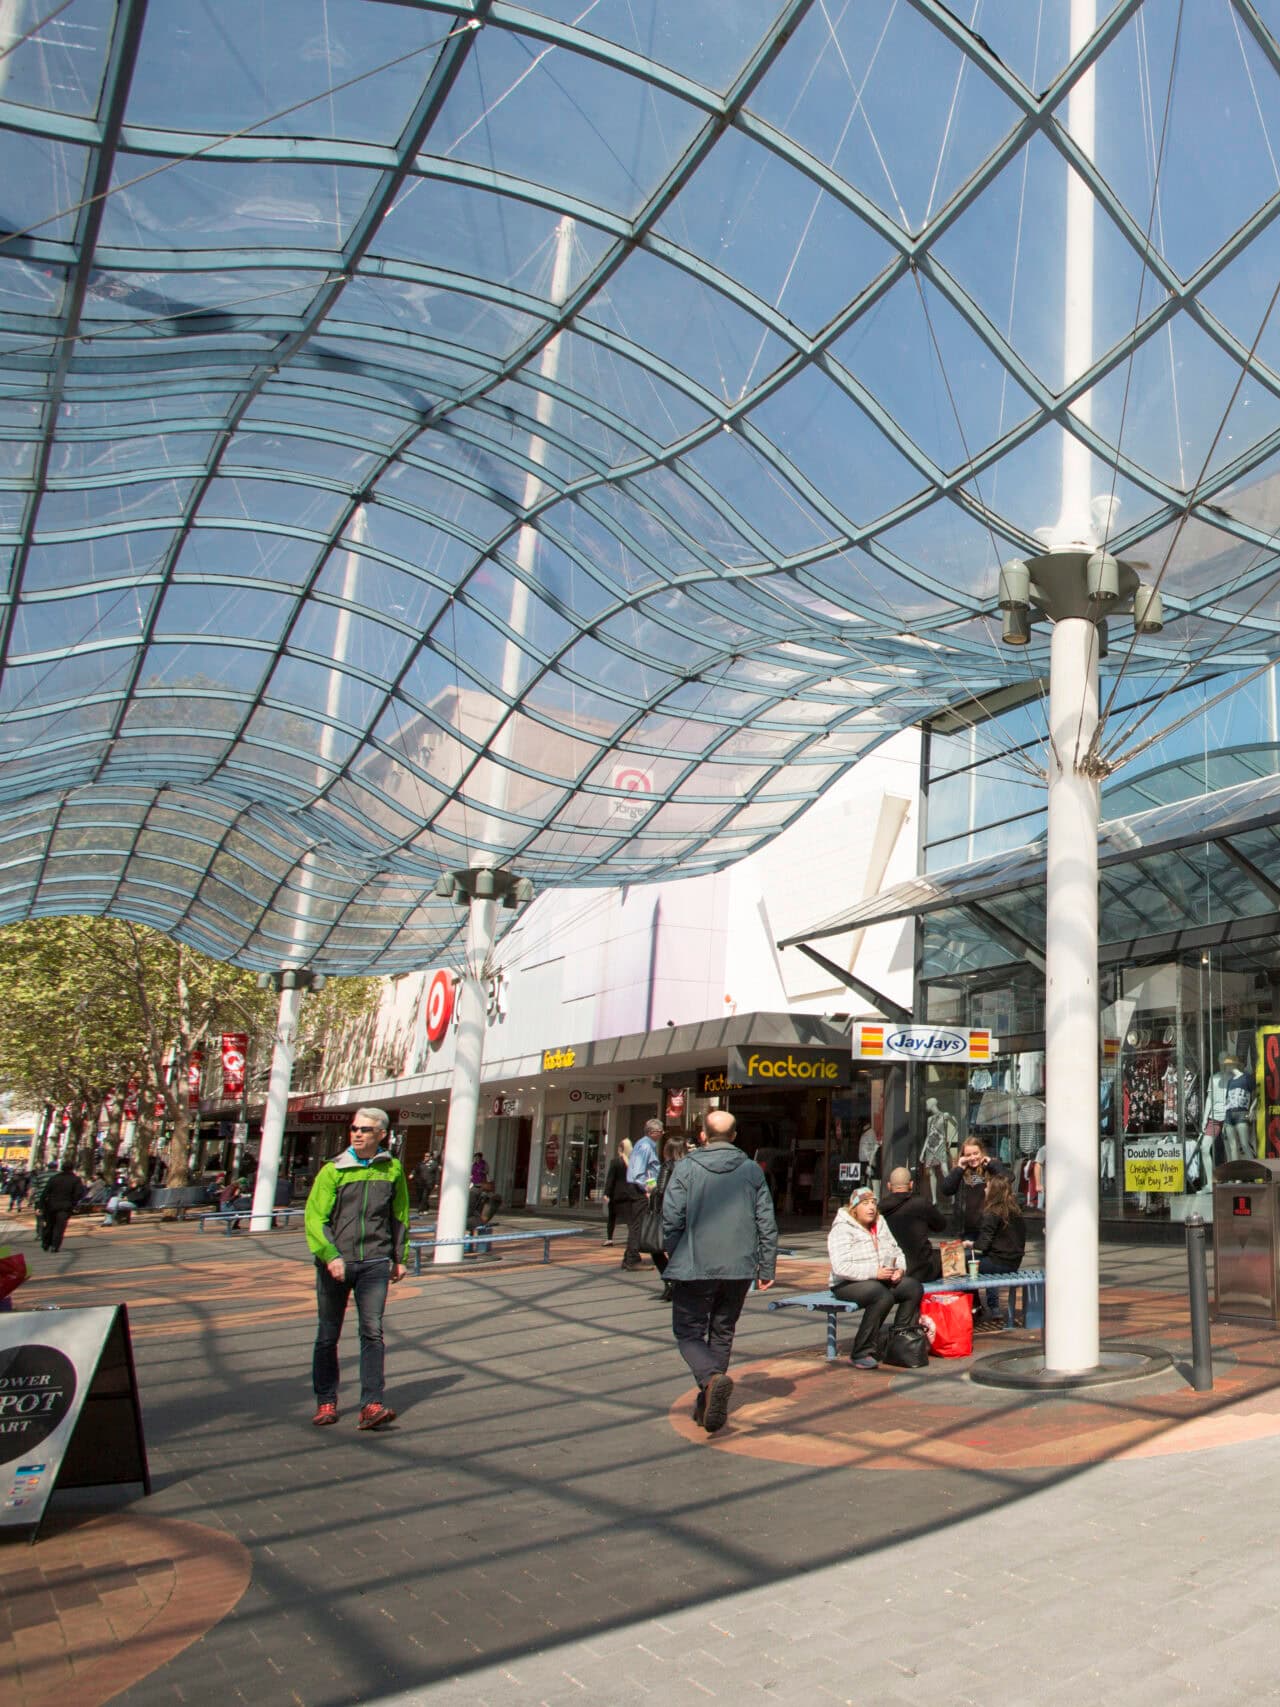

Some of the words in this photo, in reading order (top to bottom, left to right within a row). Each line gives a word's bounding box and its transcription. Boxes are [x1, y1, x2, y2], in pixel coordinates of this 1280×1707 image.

[748, 1054, 838, 1079] factorie
[583, 1091, 611, 1103] Target
[1127, 1148, 1155, 1159] Double
[1157, 1147, 1181, 1158] Deals
[840, 1164, 859, 1178] FILA
